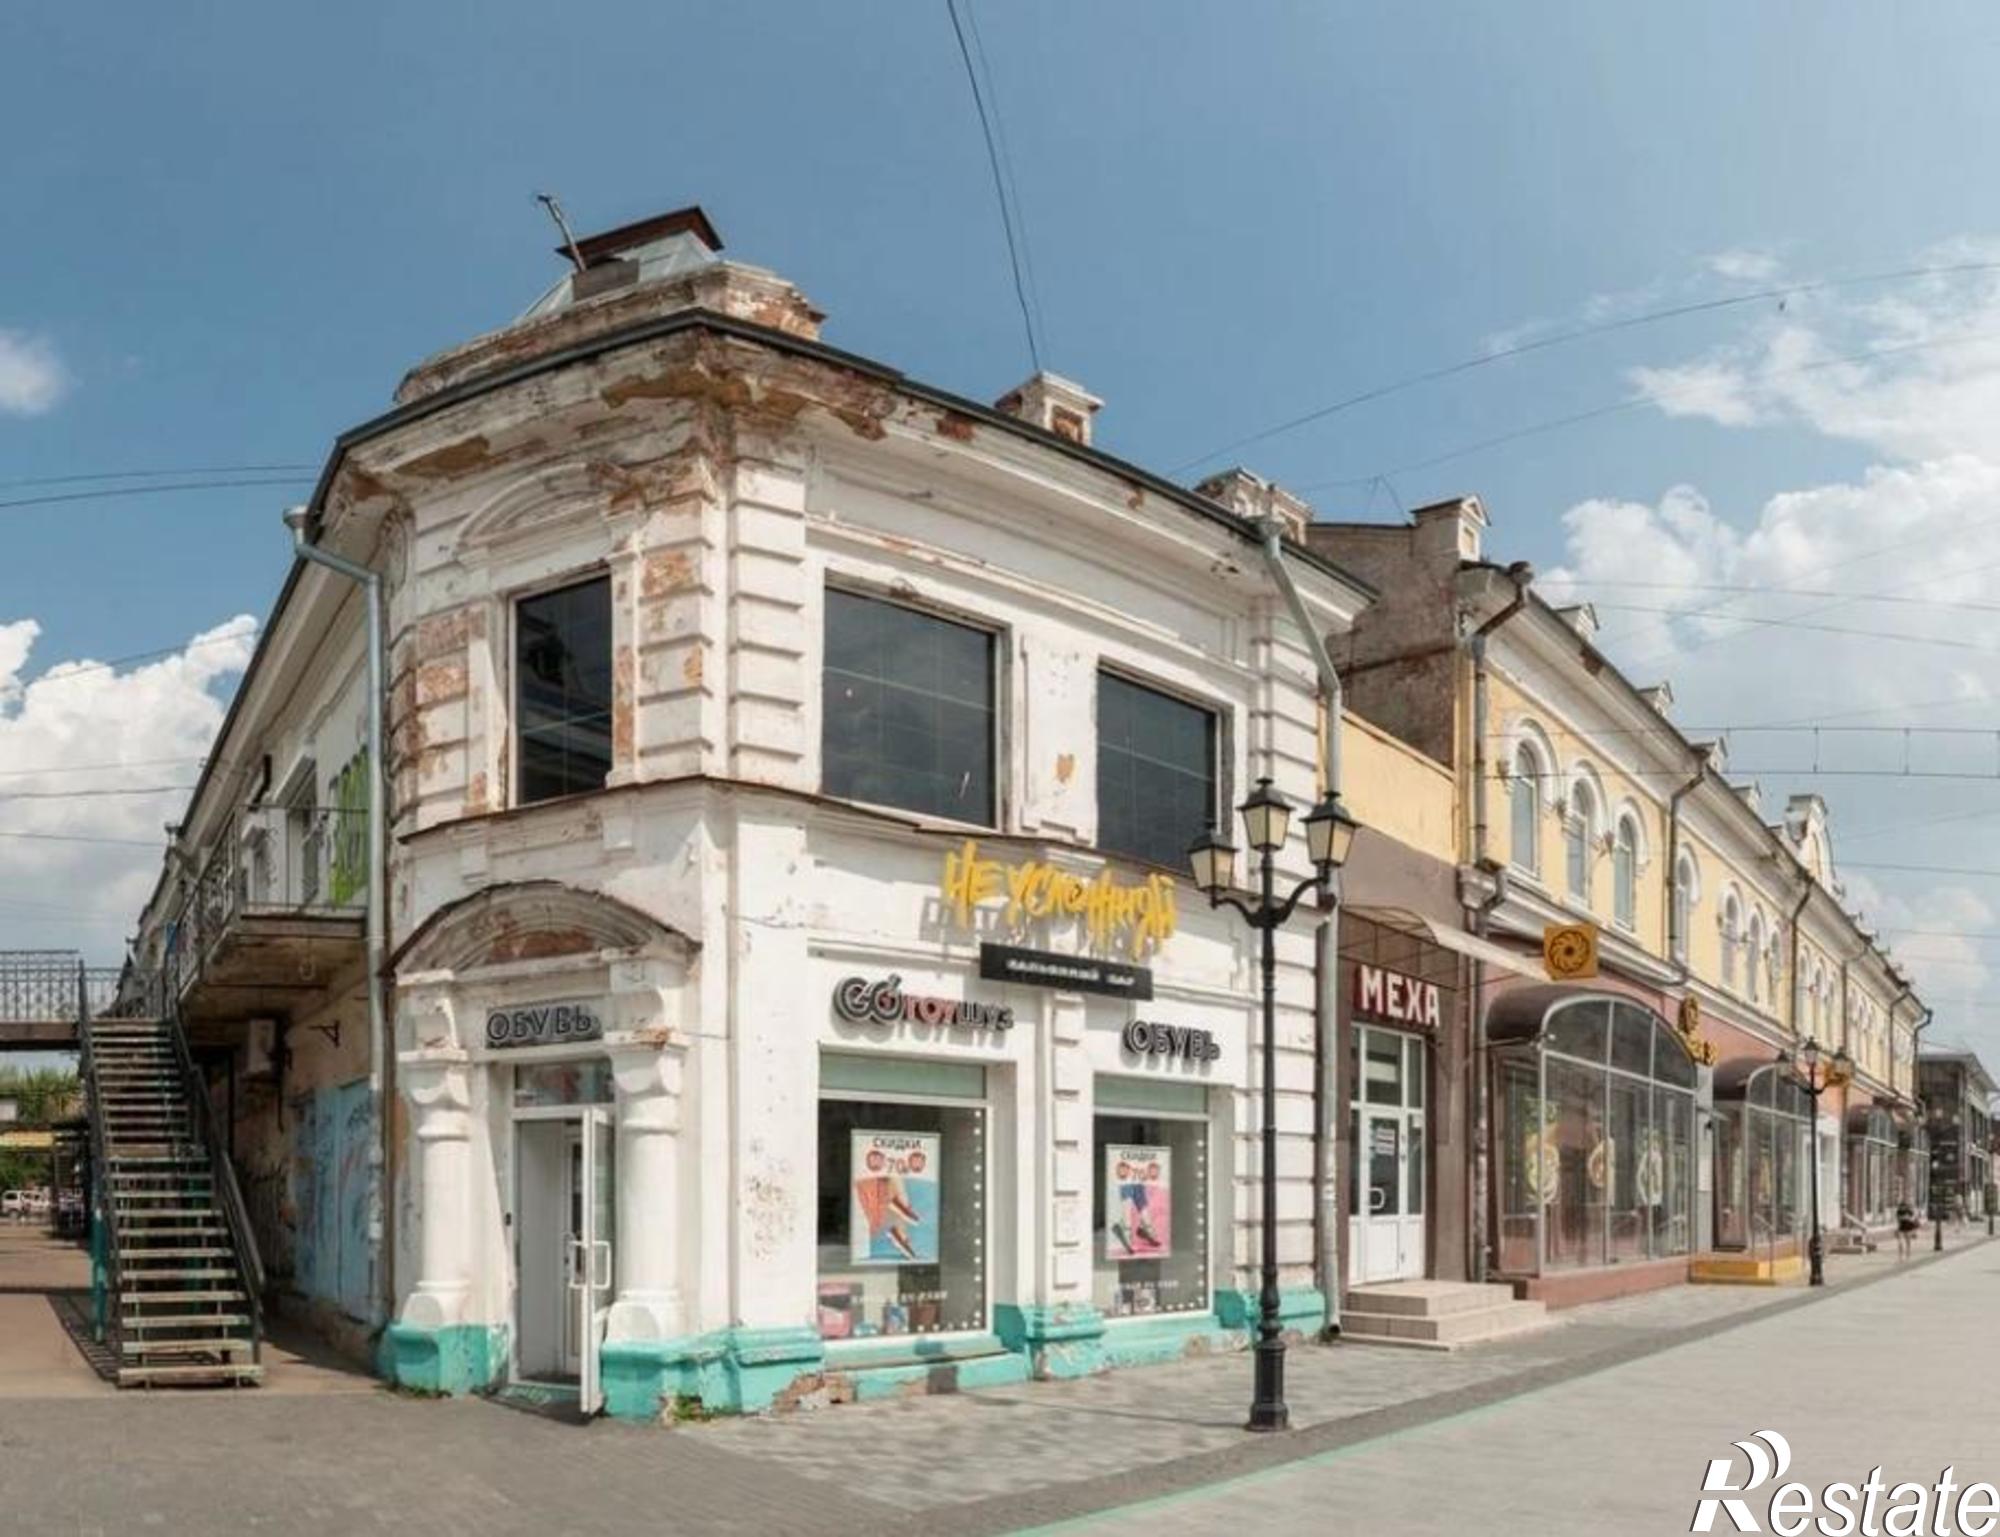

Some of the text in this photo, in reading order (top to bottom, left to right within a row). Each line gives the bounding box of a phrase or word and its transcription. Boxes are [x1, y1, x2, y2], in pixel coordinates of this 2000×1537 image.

[1360, 964, 1440, 1027] МЕХА
[486, 1005, 602, 1042] ОБУВЬ
[1122, 1020, 1221, 1062] ОБУВЬ
